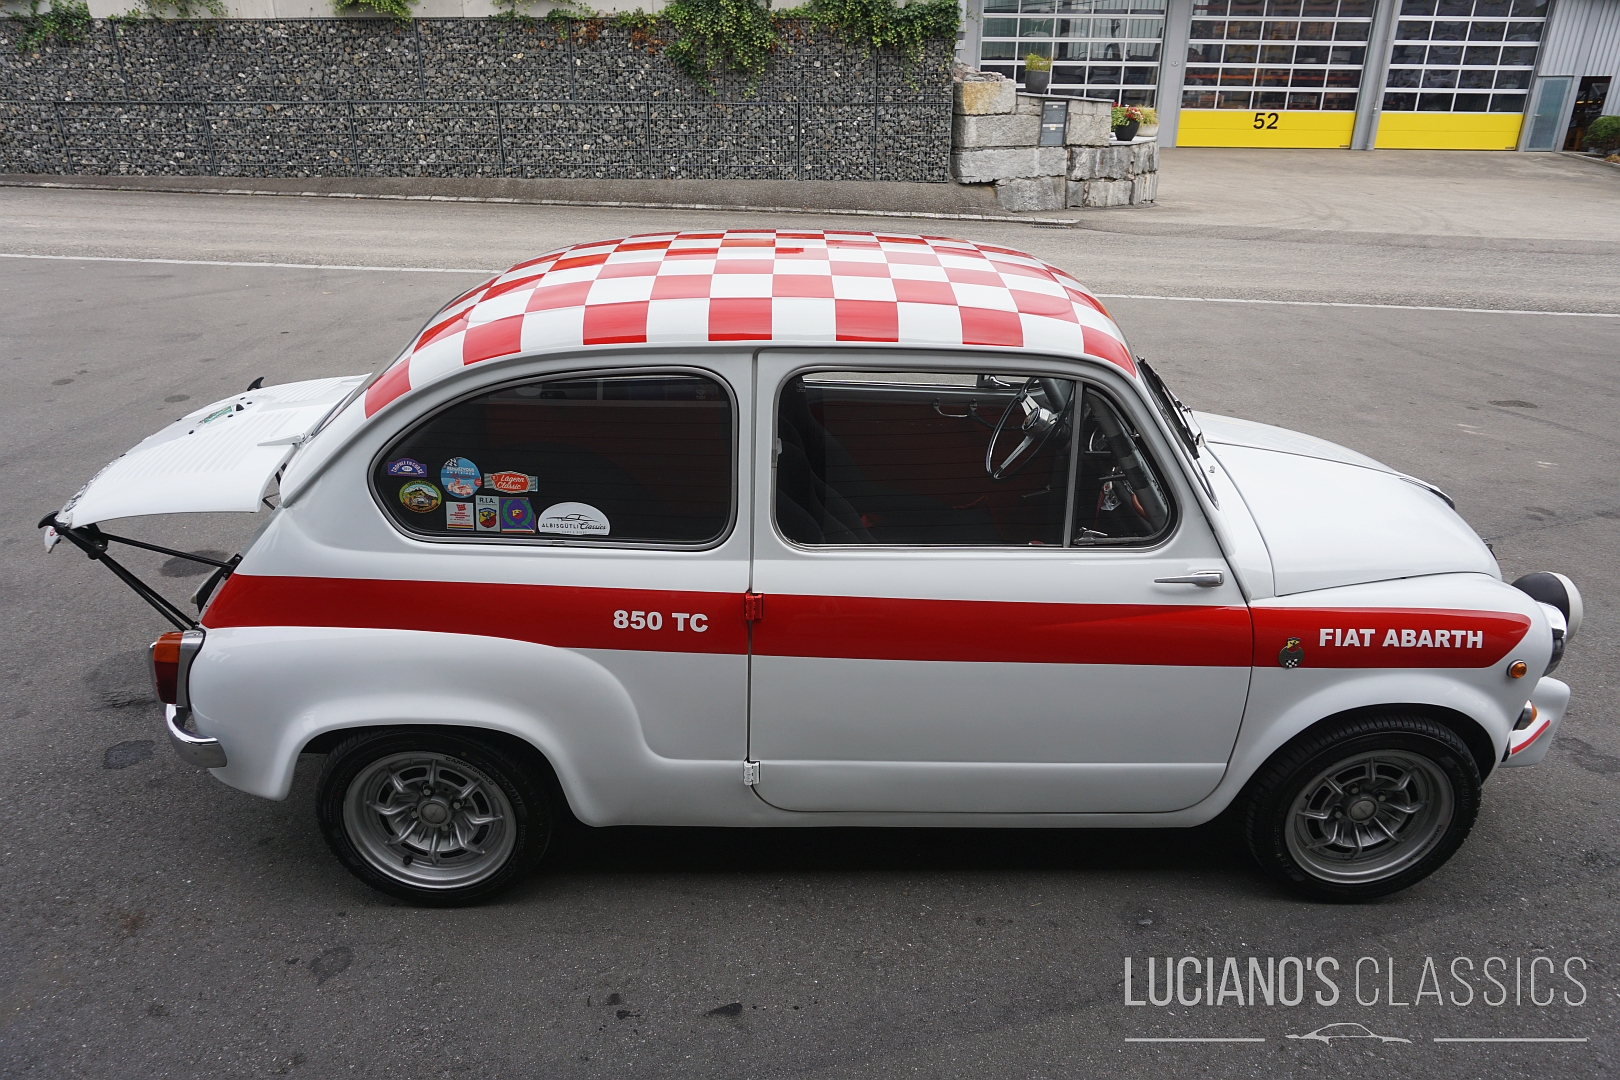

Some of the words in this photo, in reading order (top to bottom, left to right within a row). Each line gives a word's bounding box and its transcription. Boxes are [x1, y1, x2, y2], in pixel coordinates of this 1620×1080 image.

[1253, 112, 1279, 129] 52
[496, 481, 522, 490] Classic
[578, 521, 606, 530] Classics
[613, 610, 663, 630] 850
[671, 612, 709, 632] TC
[1319, 628, 1376, 647] FIAT
[1382, 629, 1484, 648] ABARTH
[445, 756, 494, 786] CAMPAGNOLO
